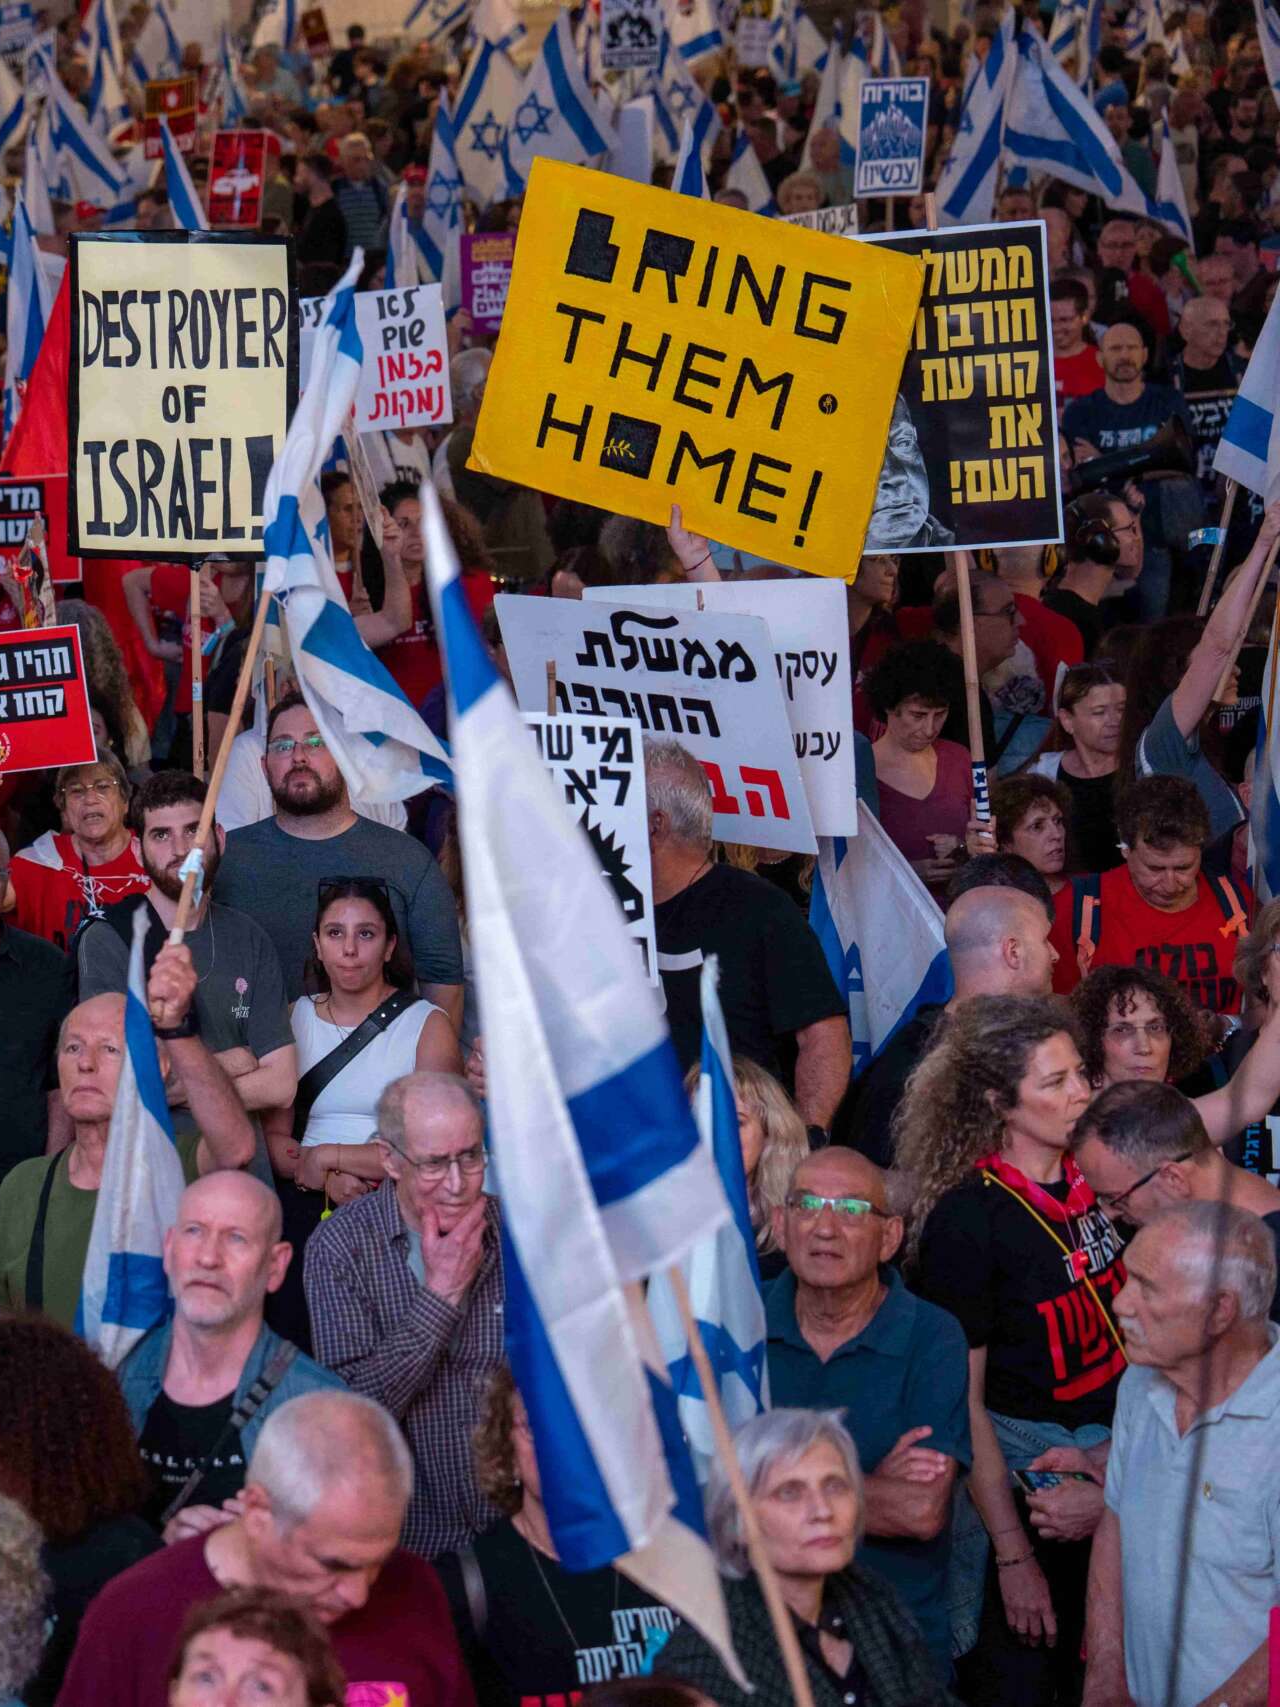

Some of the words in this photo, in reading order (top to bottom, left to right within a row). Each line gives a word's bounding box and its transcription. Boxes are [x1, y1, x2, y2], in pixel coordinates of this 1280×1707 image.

[864, 84, 924, 104] בחירות
[564, 207, 852, 344] BRING
[919, 244, 1035, 297] ממשל
[81, 287, 287, 370] DESTROYER
[933, 297, 1038, 352] חורבן
[377, 350, 443, 389] בזמן
[556, 302, 795, 431] THEM
[920, 350, 1040, 402] קורעת
[161, 384, 207, 424] OF
[988, 402, 1044, 450] את
[82, 434, 275, 541] ISRAEL!
[536, 393, 823, 548] HOME!
[949, 455, 1047, 505] העם!
[13, 646, 71, 680] תהיו
[574, 610, 758, 683] ממשלת
[15, 687, 65, 719] קחו
[792, 731, 841, 761] עכש
[564, 765, 632, 807] לא
[574, 1641, 646, 1684] הביתה
